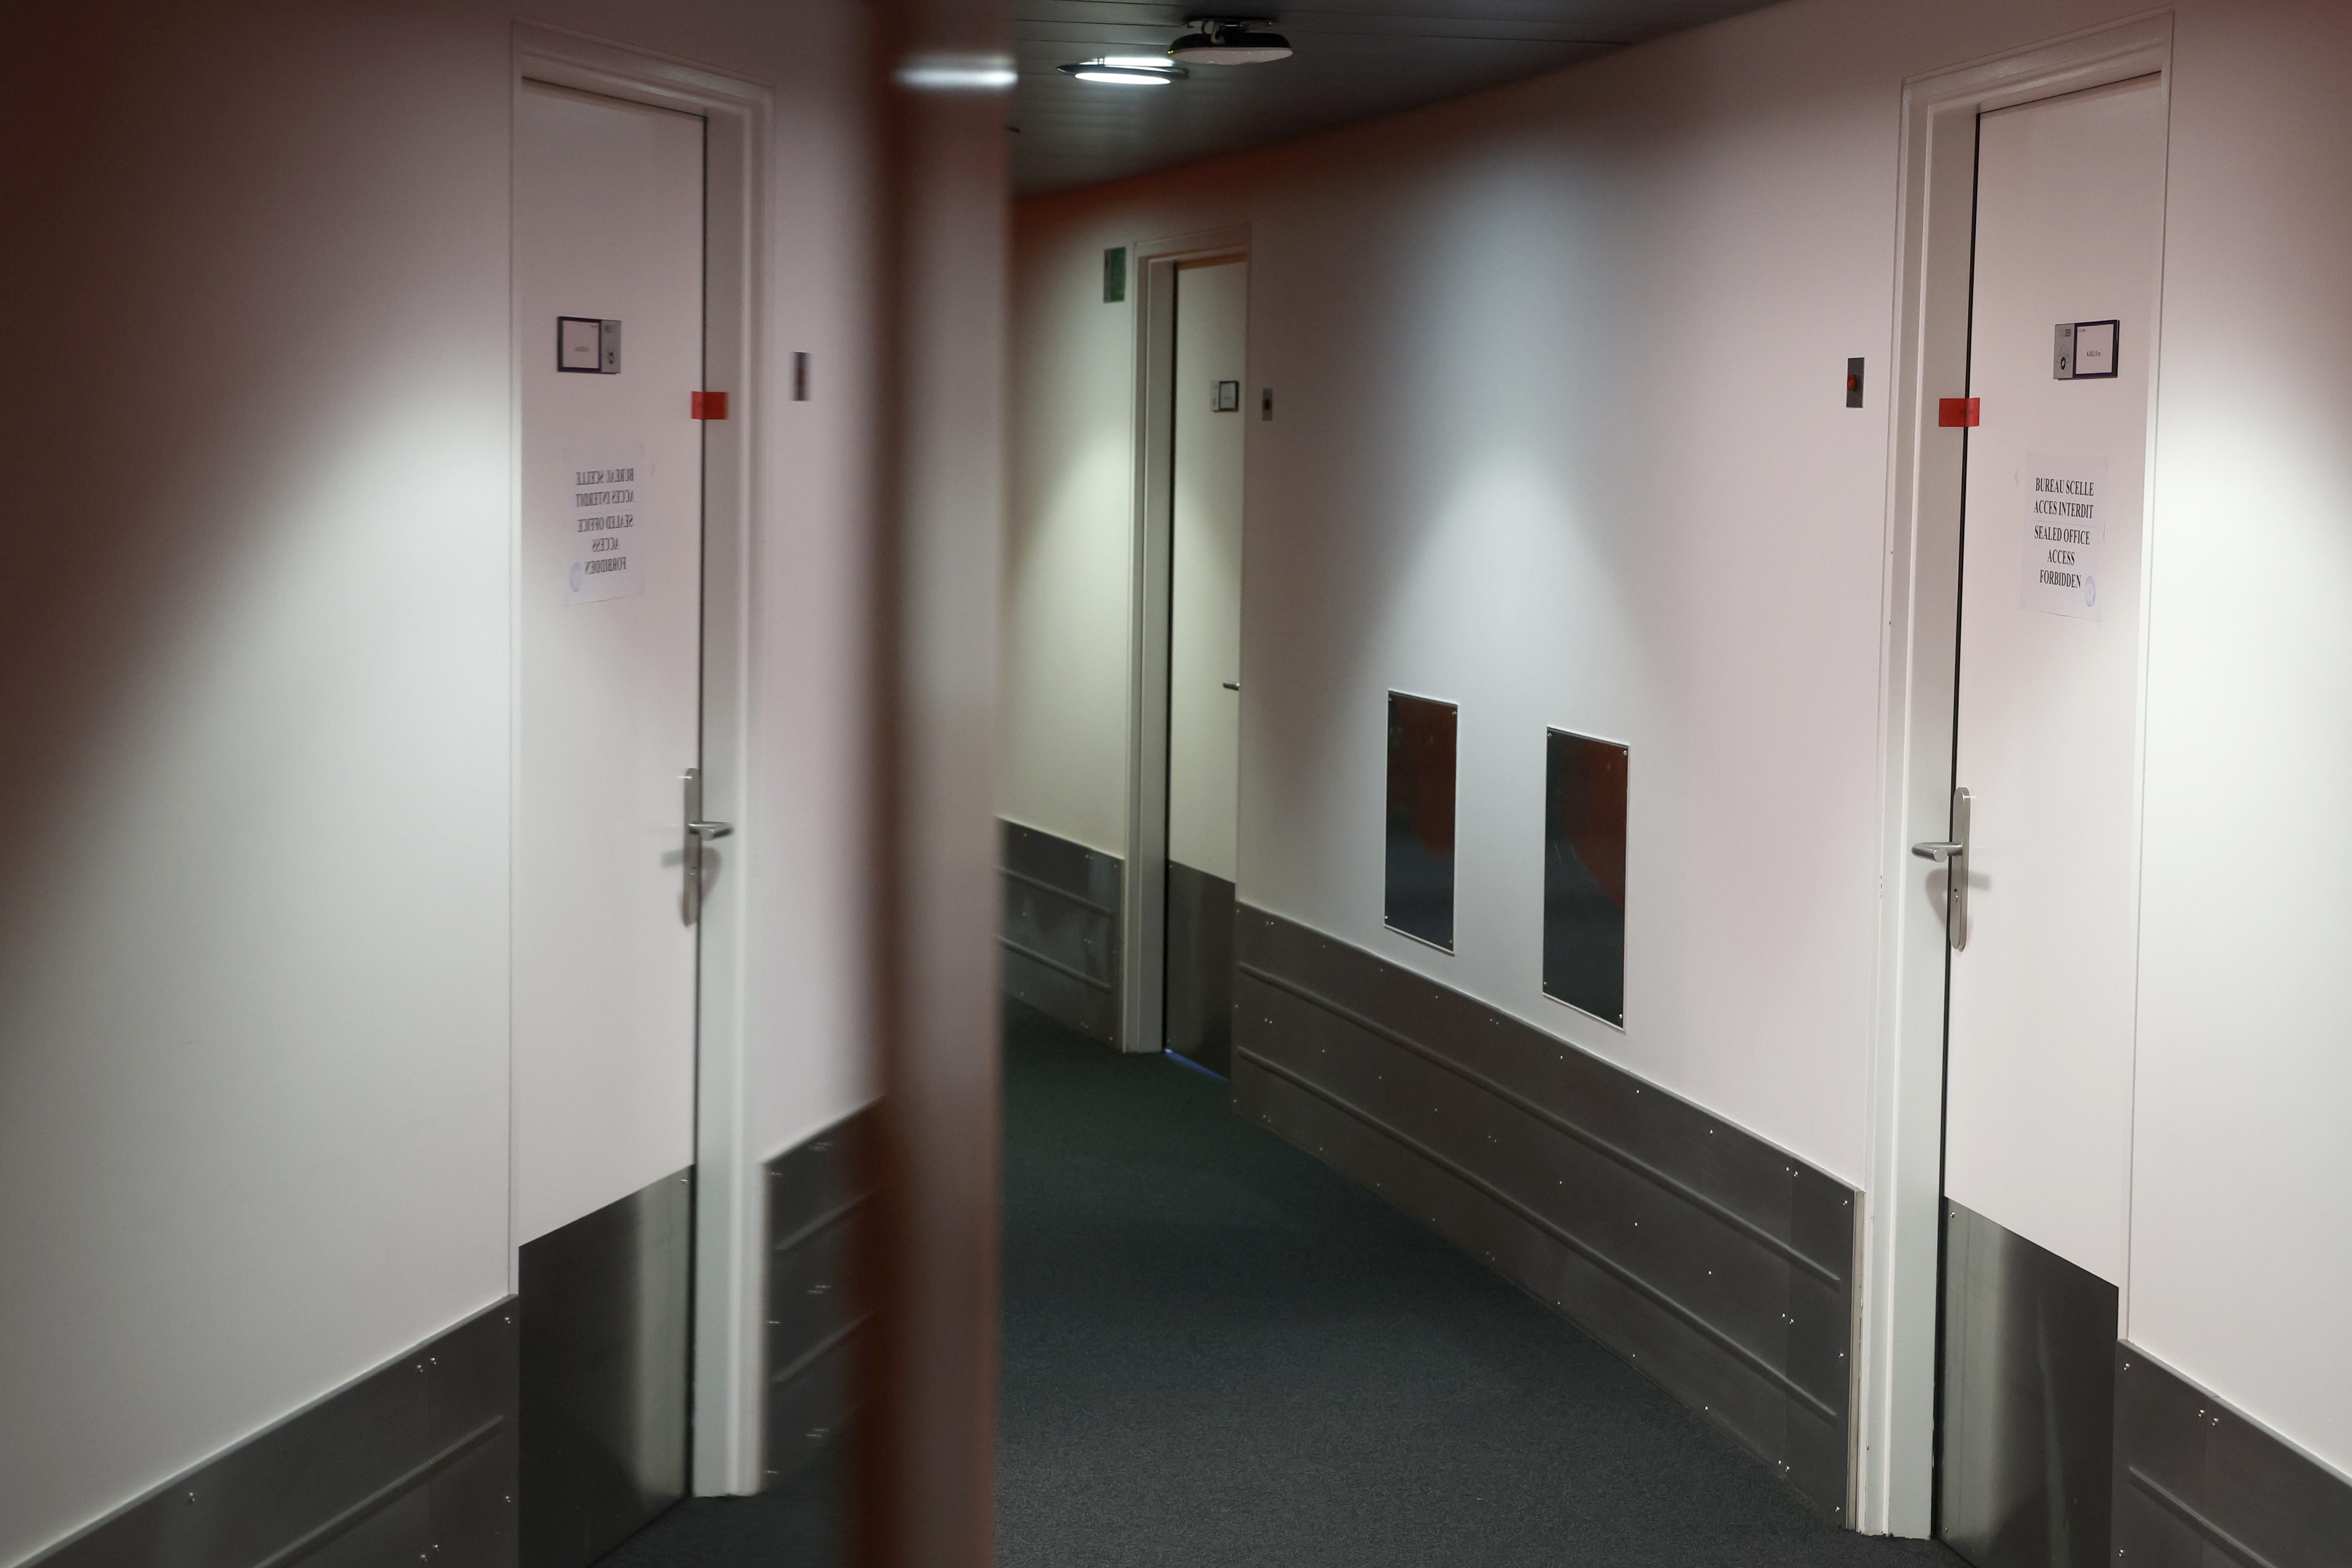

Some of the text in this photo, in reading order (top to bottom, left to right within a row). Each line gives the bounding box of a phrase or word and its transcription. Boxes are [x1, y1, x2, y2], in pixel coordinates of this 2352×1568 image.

[2035, 477, 2094, 496] BUREAU SCELLE
[2033, 500, 2094, 519] ACCES INTERDIT
[2034, 525, 2090, 545] SEALED OFFICE
[2047, 549, 2075, 566] ACCESS
[2039, 570, 2082, 589] FORBIDDEN
